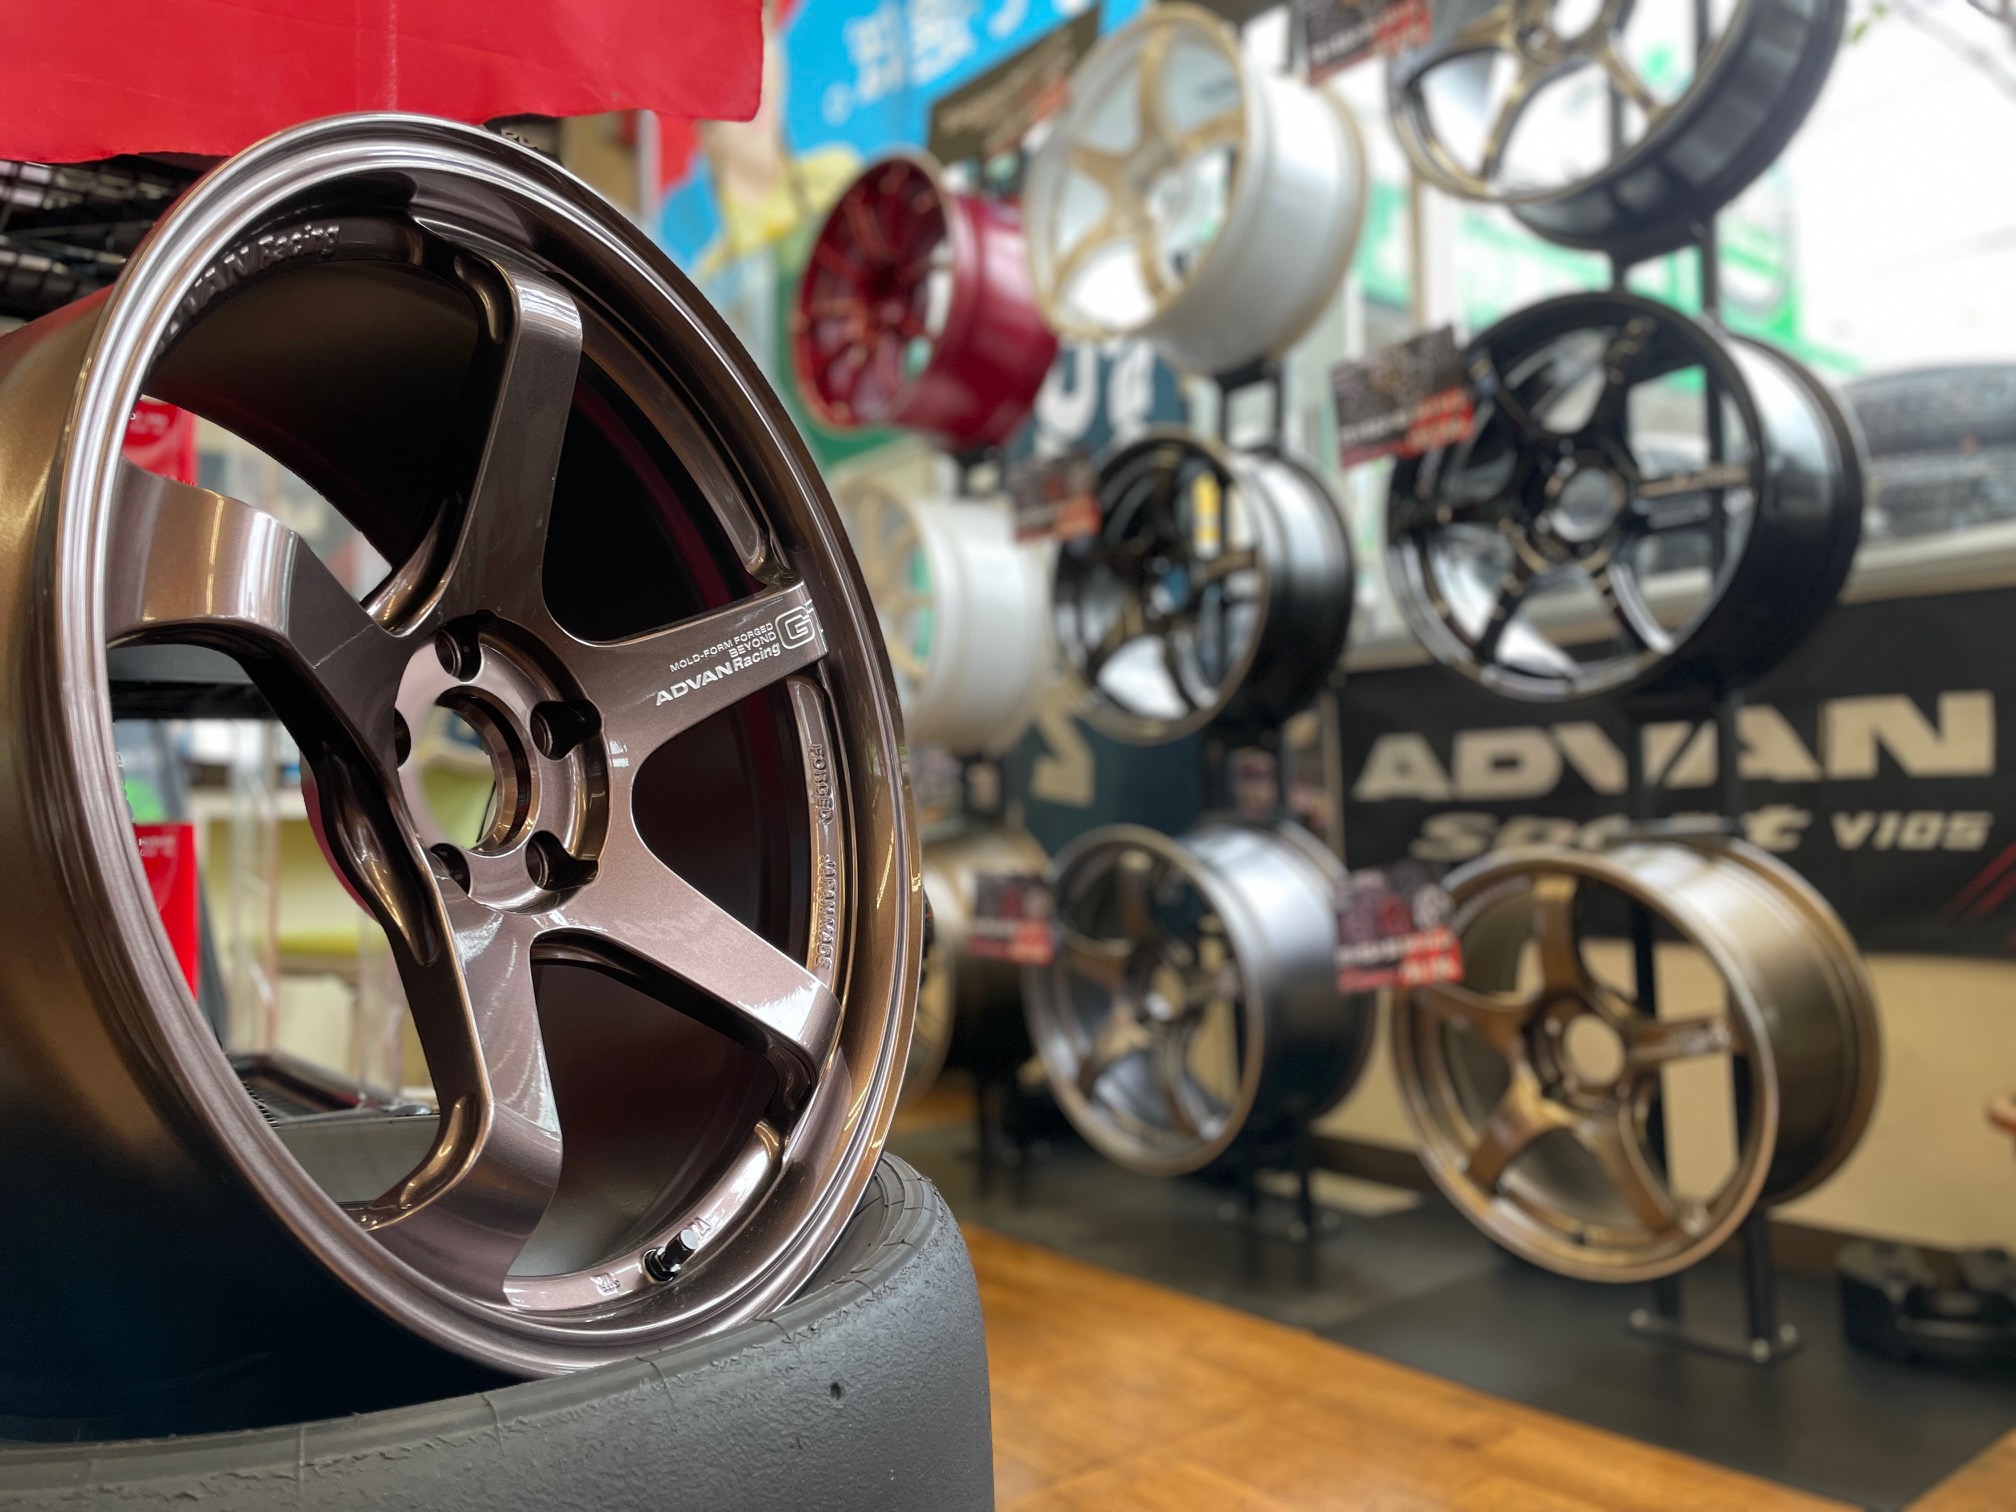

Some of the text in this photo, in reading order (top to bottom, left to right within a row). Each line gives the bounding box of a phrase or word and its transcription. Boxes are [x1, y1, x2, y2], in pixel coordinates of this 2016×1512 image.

[669, 623, 774, 672] MOLD-FORM FORGED
[728, 632, 777, 658] BEYOND
[1352, 689, 1996, 803] ADVAN
[809, 743, 833, 824] FORGED
